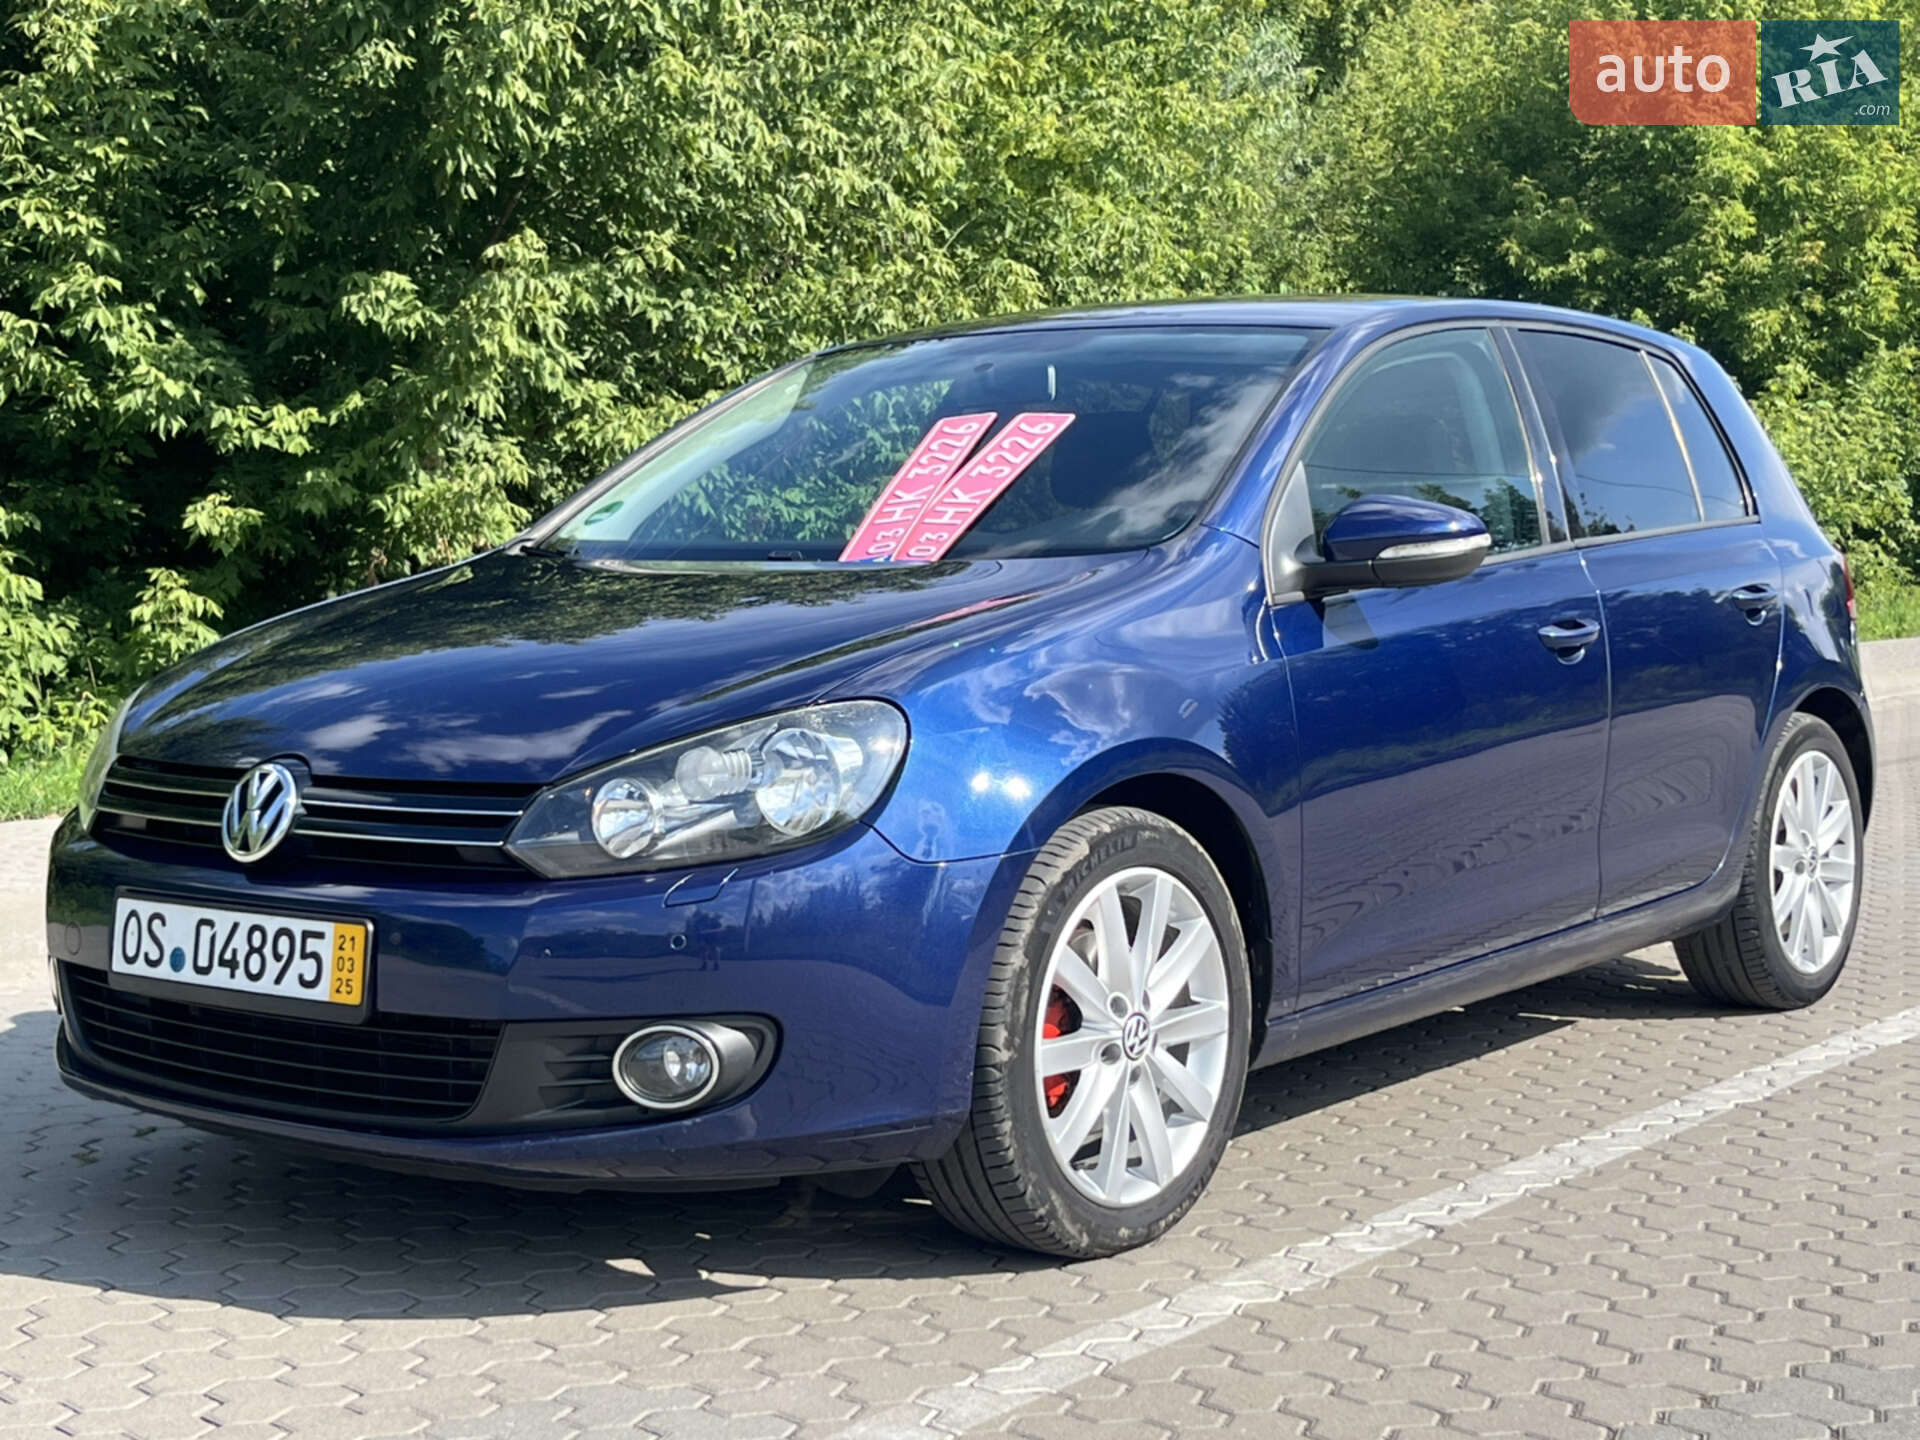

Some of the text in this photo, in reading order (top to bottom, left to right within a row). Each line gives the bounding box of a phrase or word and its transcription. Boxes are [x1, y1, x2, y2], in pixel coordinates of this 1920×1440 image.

[867, 421, 979, 555] 03 HK 3226
[907, 422, 1055, 557] 03 HK 3226
[122, 909, 326, 989] OS 04895
[336, 957, 355, 973] 03
[338, 935, 356, 951] 21
[335, 978, 353, 995] 25
